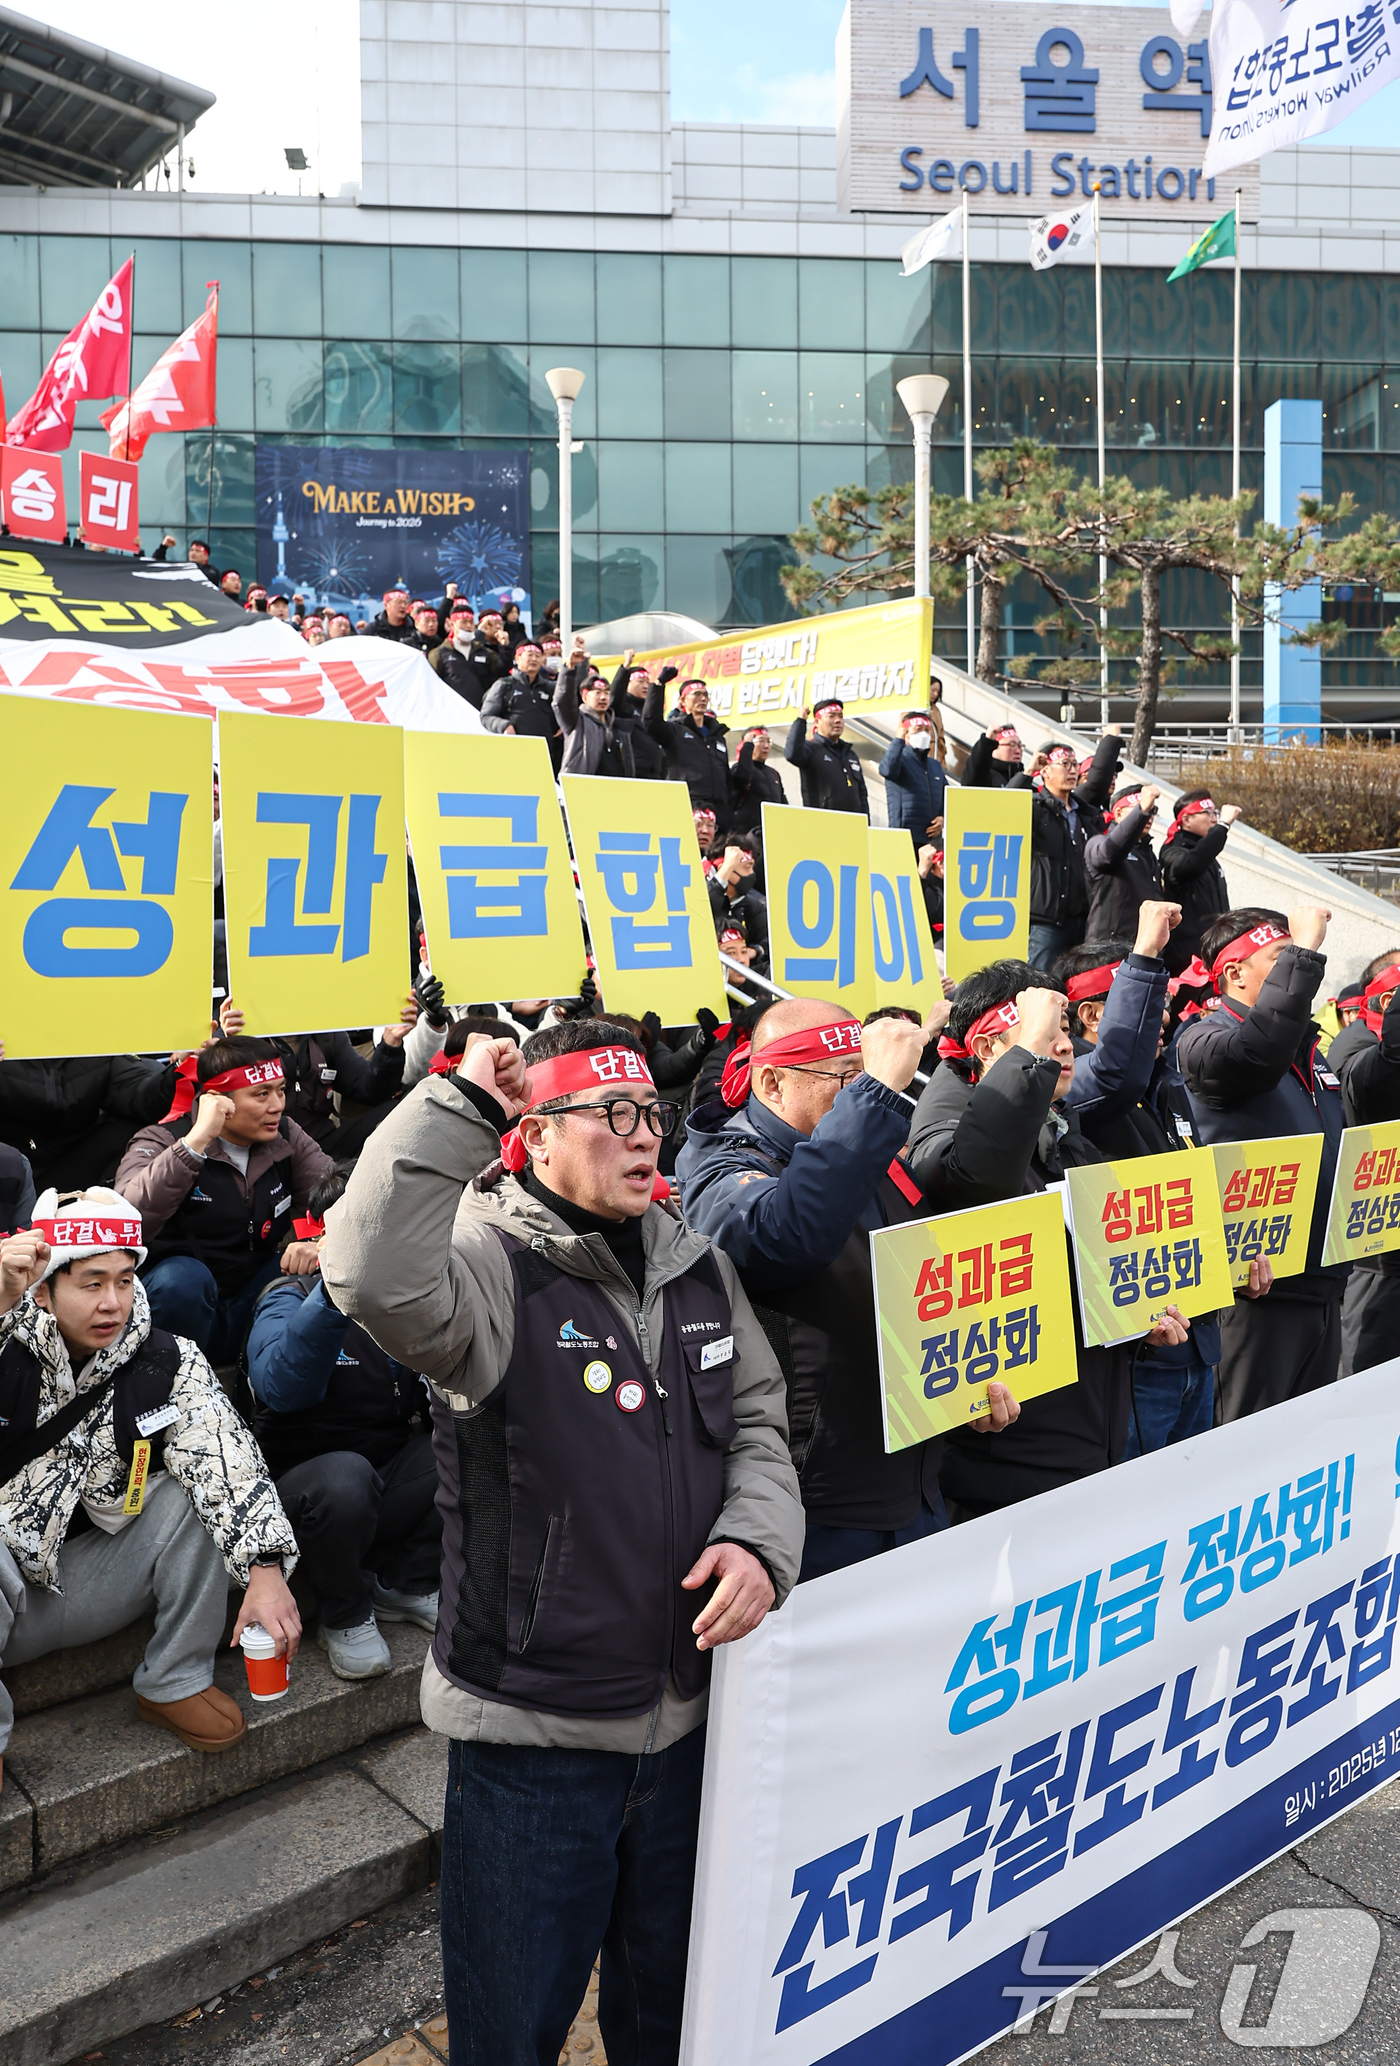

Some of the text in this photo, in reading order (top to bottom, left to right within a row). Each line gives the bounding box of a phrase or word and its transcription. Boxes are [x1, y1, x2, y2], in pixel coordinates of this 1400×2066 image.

[899, 27, 1212, 137] 서울역
[900, 147, 1216, 200] Seoul Station
[11, 467, 132, 532] 승 리
[302, 481, 381, 514] MAKE
[395, 489, 476, 516] WISH
[737, 673, 806, 715] 반드시
[811, 659, 915, 704] 해결하자
[9, 784, 1024, 988] 성 과 급 합 의 이 행
[244, 1061, 275, 1085] 단결
[590, 1048, 641, 1082] 단결
[1223, 1163, 1301, 1213] 성과급
[1352, 1147, 1400, 1191] 성과
[53, 1220, 95, 1245] 단결
[1101, 1177, 1194, 1243] 성과급
[1224, 1214, 1293, 1265] 정상화
[913, 1232, 1034, 1322] 성과급
[1109, 1237, 1203, 1307] 정상화
[920, 1305, 1041, 1400] 정상화
[943, 1453, 1356, 1736] 성과급 정상화!
[771, 1552, 1400, 2035] 전국철도노동조합
[1284, 1781, 1316, 1828] 일시
[1328, 1735, 1386, 1797] 2025년
